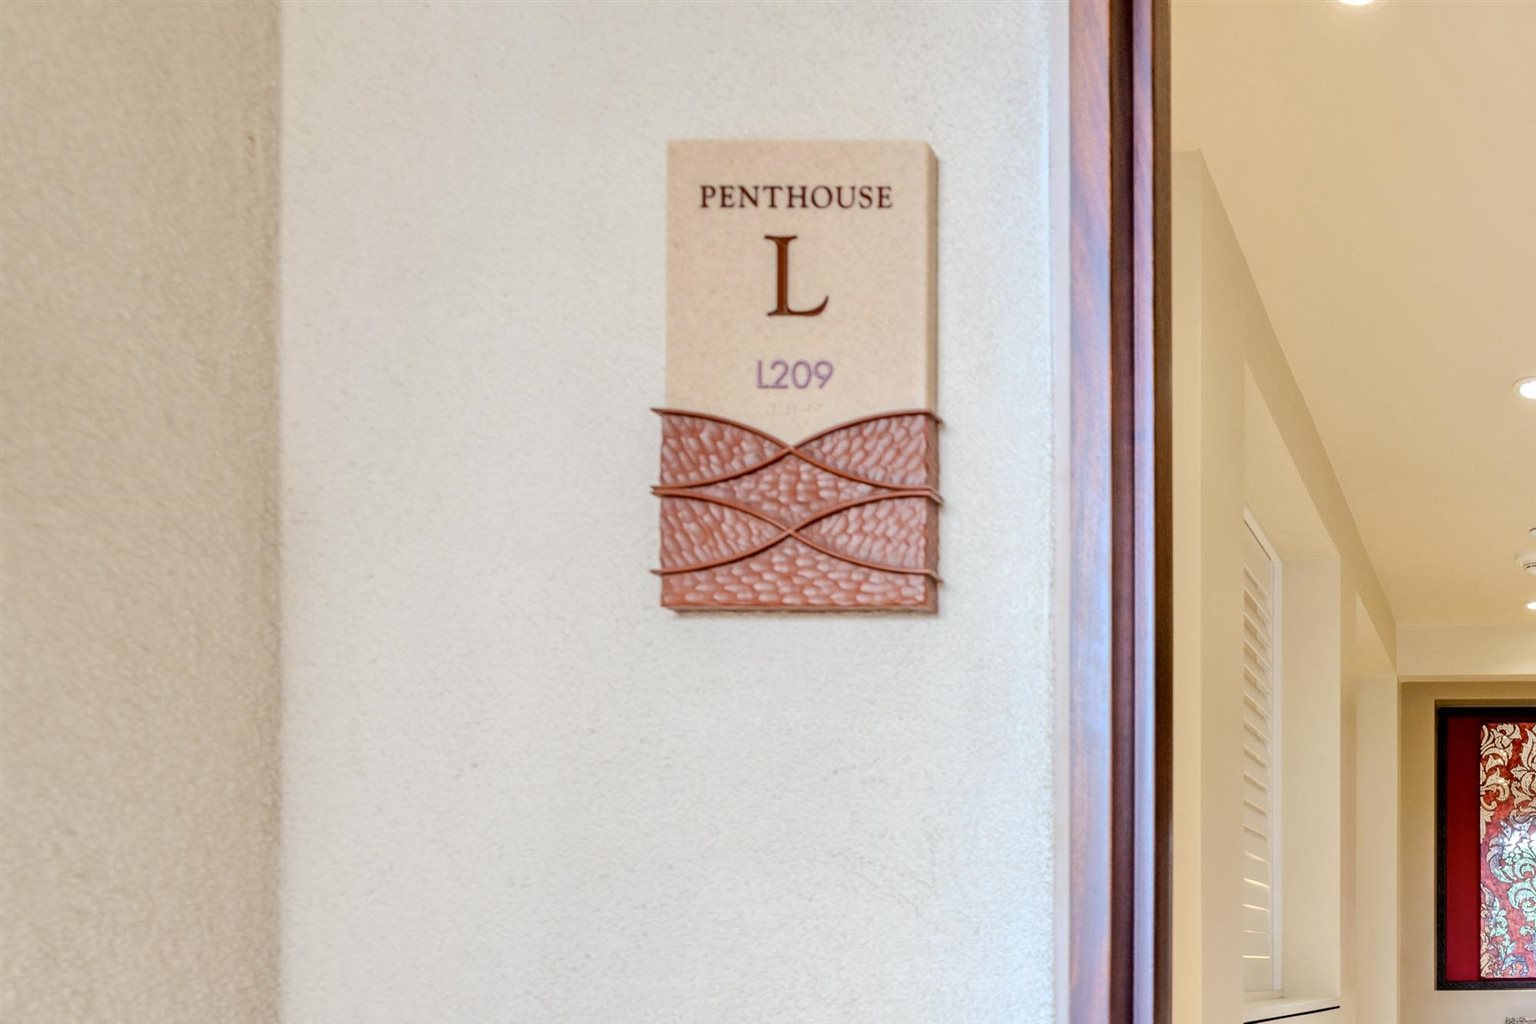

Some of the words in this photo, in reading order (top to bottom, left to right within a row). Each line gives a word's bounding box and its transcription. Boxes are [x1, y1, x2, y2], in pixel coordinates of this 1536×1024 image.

[699, 185, 893, 209] PENTHOUSE
[764, 234, 829, 317] L
[756, 360, 834, 389] L209
